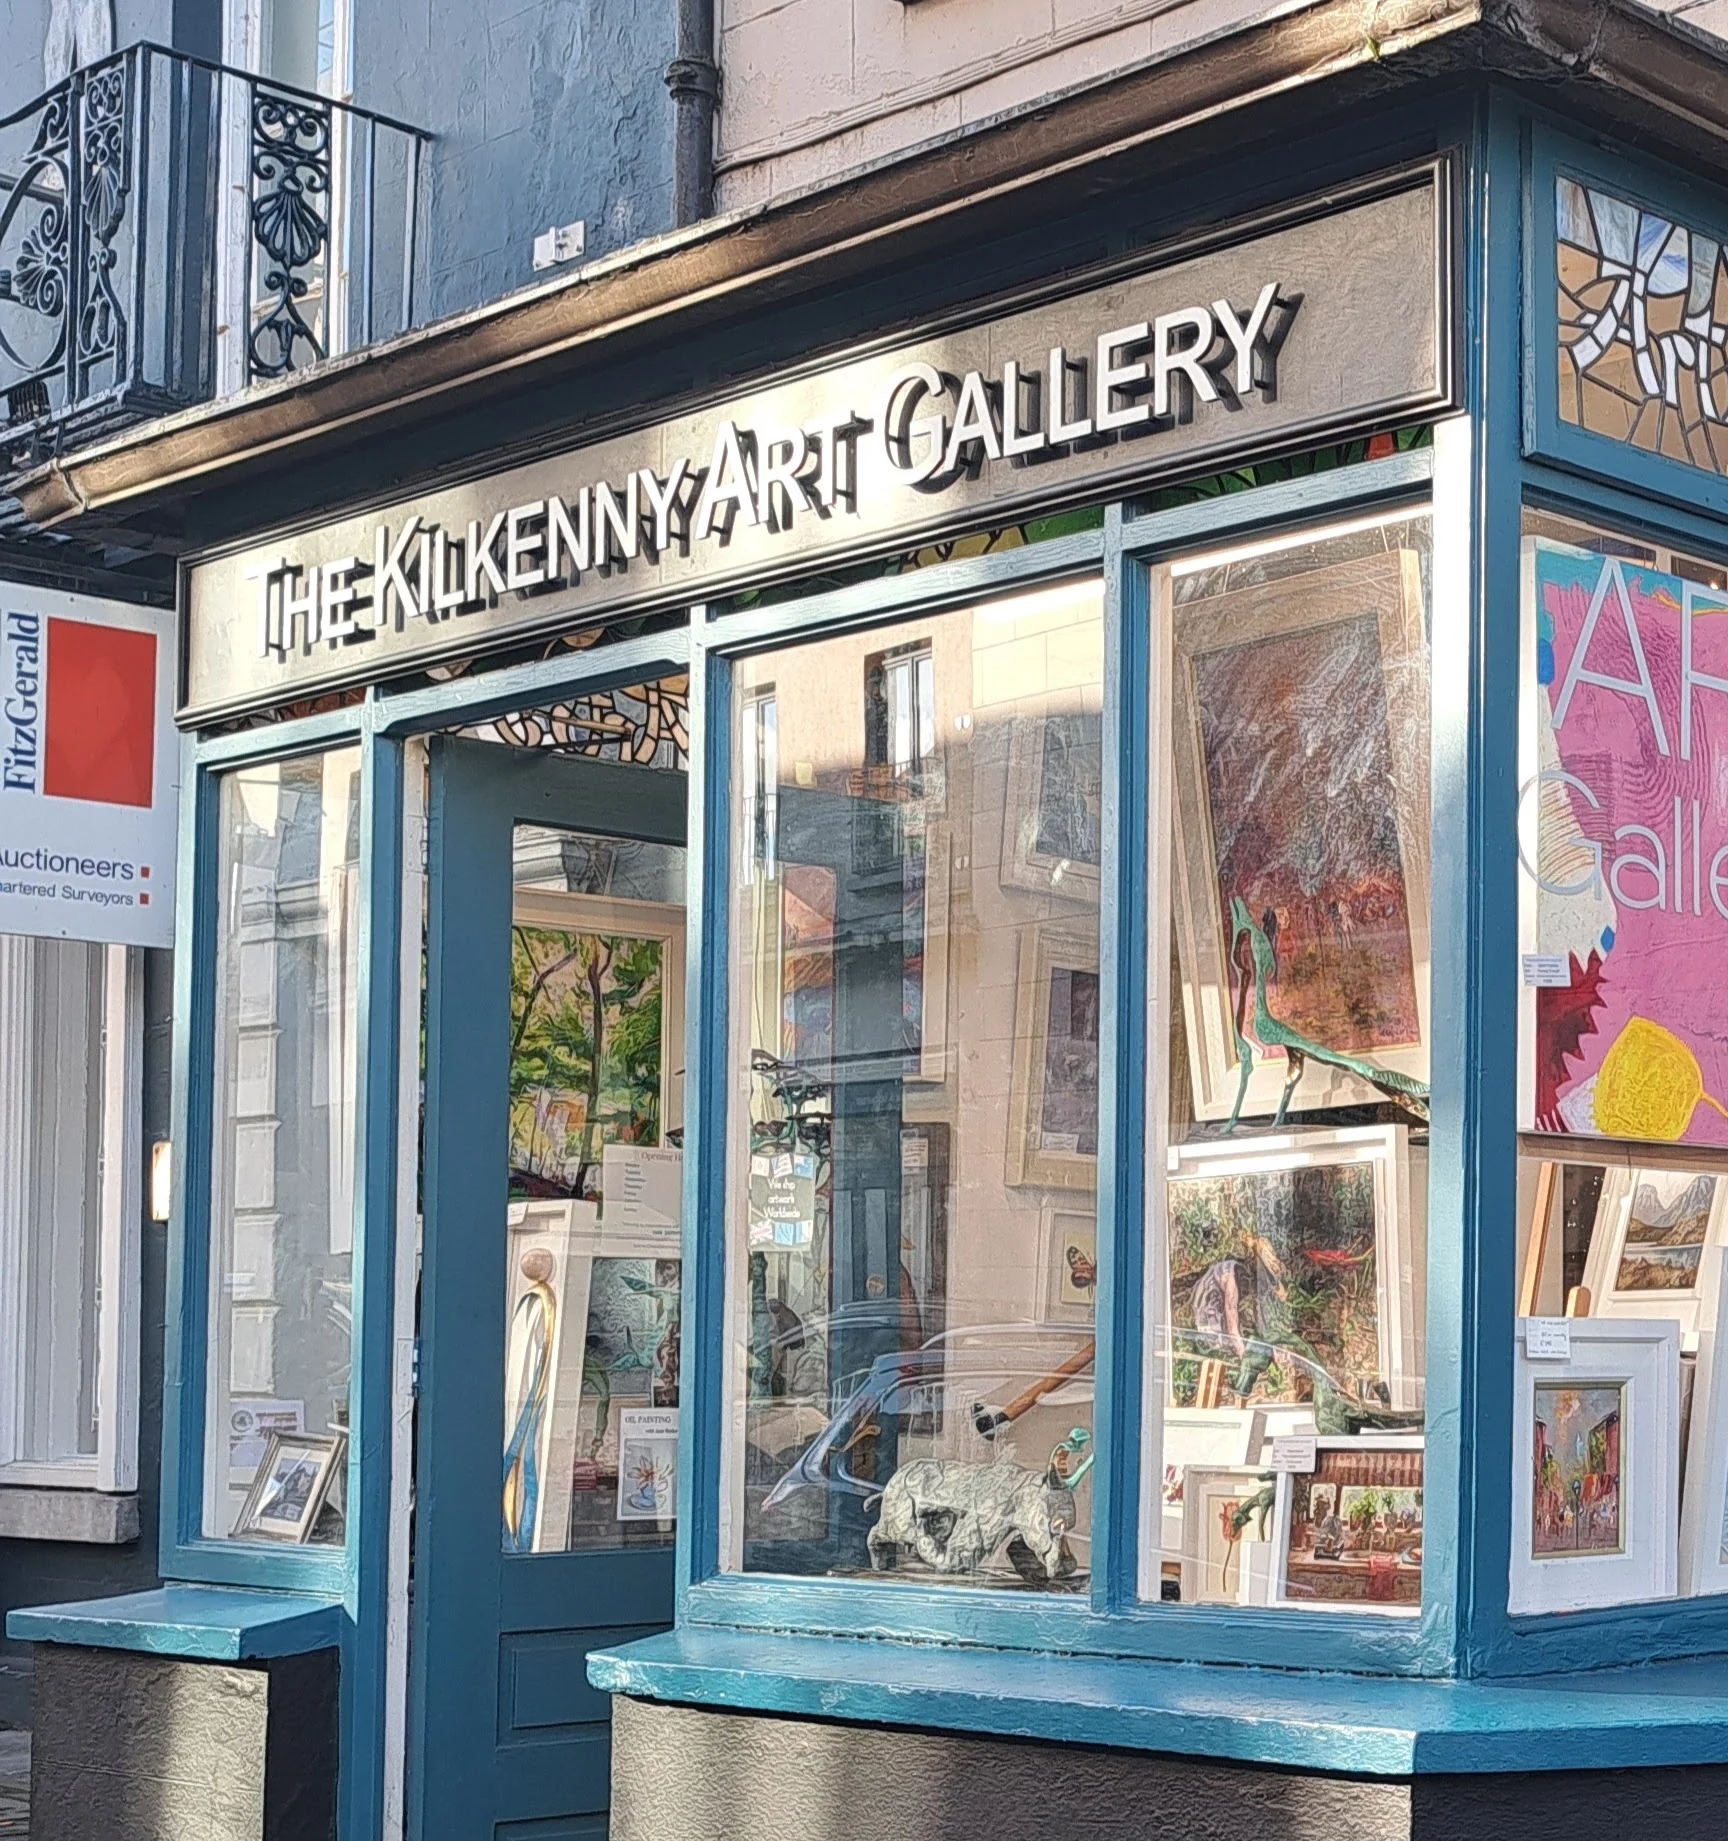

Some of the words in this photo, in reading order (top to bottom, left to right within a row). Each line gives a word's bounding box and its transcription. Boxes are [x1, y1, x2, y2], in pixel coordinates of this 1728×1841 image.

[244, 556, 360, 658] THE
[374, 457, 691, 627] KILKENNY
[694, 412, 864, 541] ART
[886, 281, 1281, 487] GALLERY
[3, 611, 40, 795] FitzGerald
[0, 880, 56, 898] artered
[61, 884, 134, 907] Surveyors
